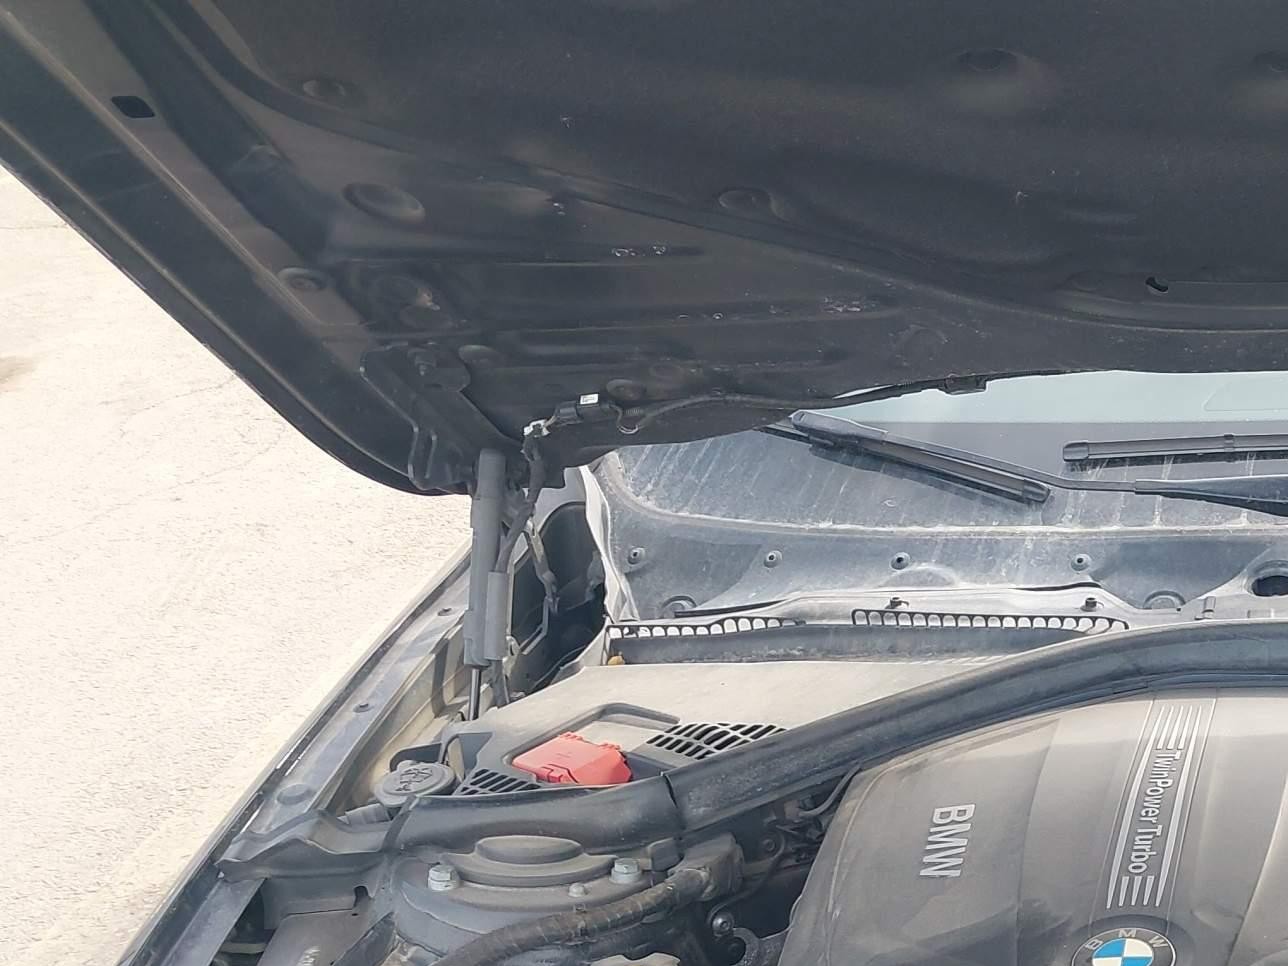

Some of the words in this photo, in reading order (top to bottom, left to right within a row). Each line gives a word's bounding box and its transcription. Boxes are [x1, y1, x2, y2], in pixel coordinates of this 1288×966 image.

[1140, 750, 1181, 824] TwinPower
[920, 803, 976, 877] BMW
[1128, 824, 1163, 874] Turbo
[1084, 929, 1168, 950] BMW
